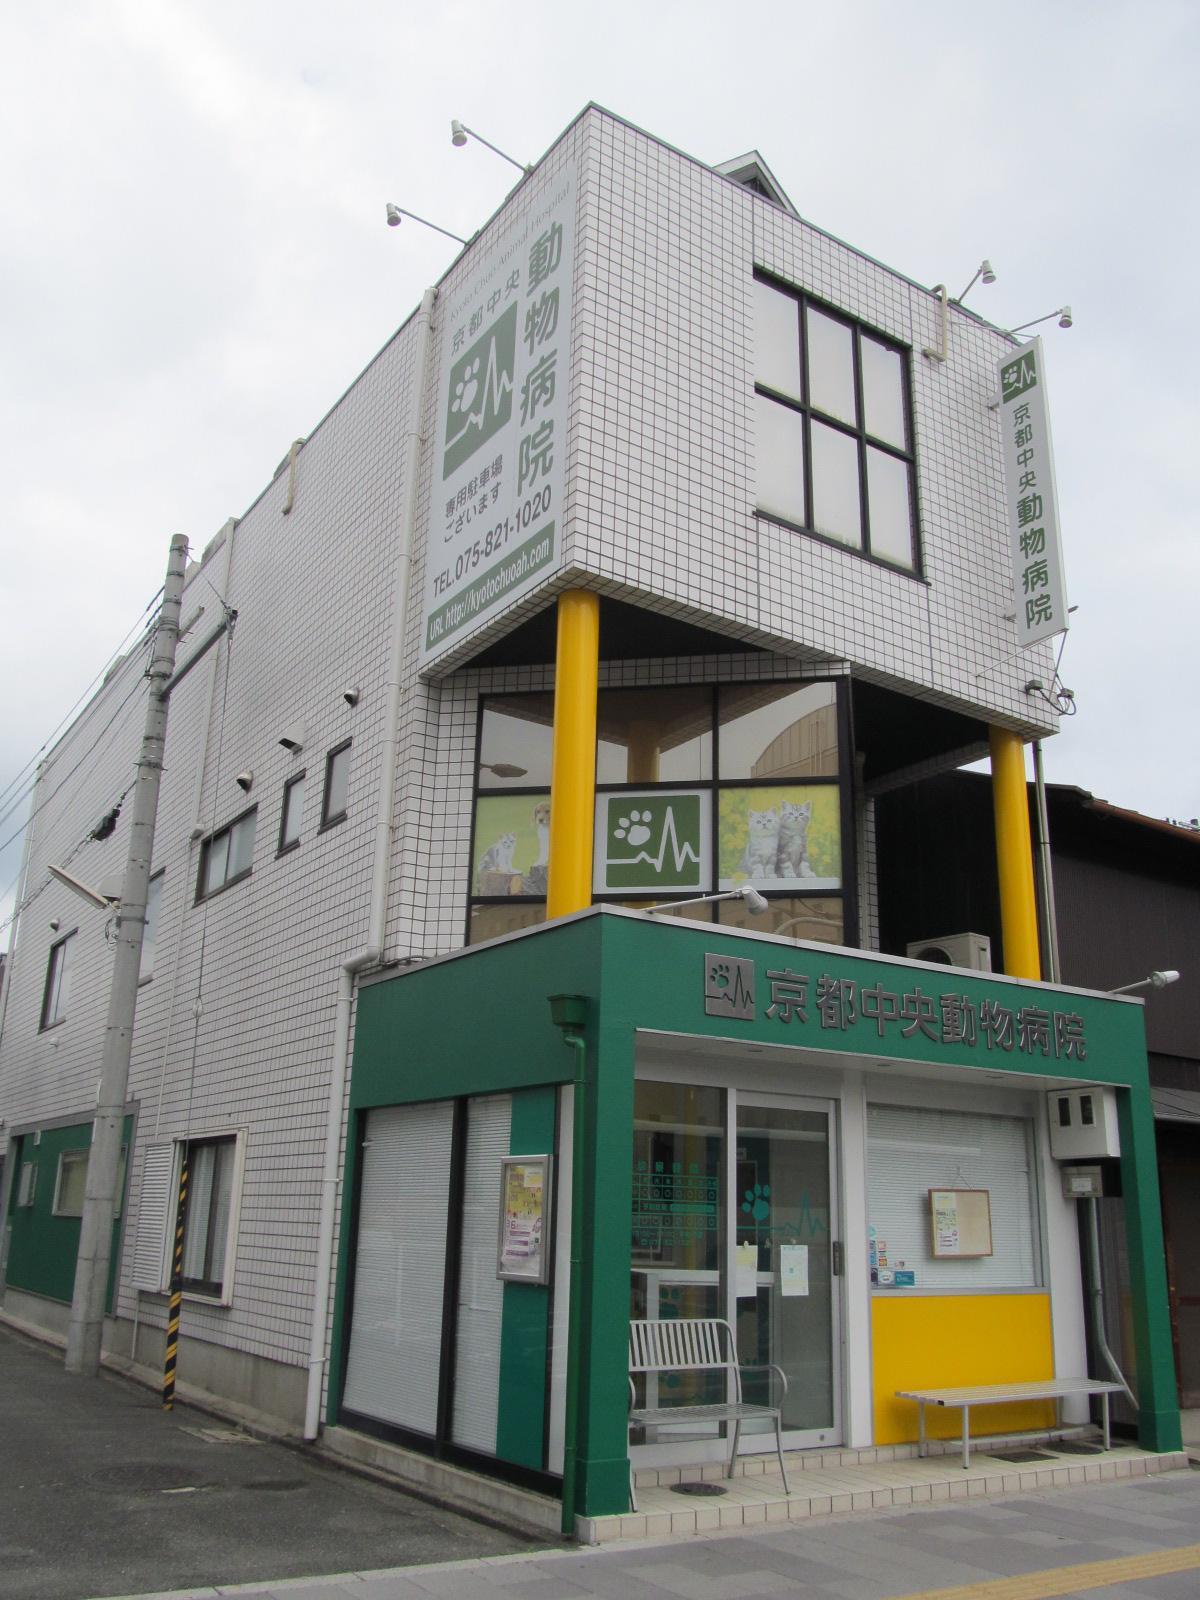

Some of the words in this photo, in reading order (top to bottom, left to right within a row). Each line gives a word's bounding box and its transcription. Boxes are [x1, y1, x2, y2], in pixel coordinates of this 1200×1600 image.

[451, 267, 520, 357] 京都中央
[516, 220, 563, 498] 動物病院
[443, 481, 502, 543] ございます
[444, 453, 503, 519] 専用駐車場
[429, 618, 444, 641] URL
[764, 967, 1088, 1062] 京都中央動物病院
